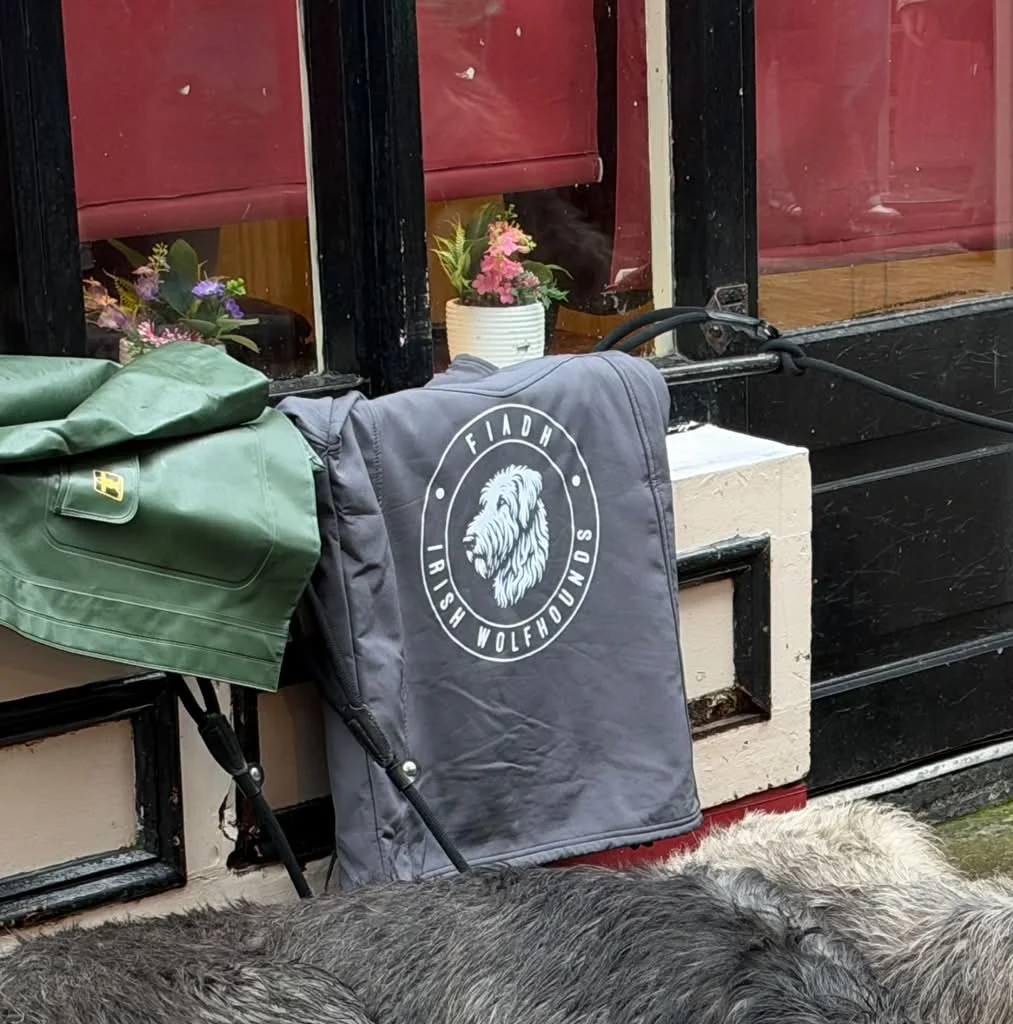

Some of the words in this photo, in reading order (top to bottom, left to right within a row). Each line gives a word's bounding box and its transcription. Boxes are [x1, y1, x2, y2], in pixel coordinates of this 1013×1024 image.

[465, 413, 553, 455] FIADH
[427, 544, 466, 628] IRISH
[477, 529, 593, 652] WOLFHOUNDS
